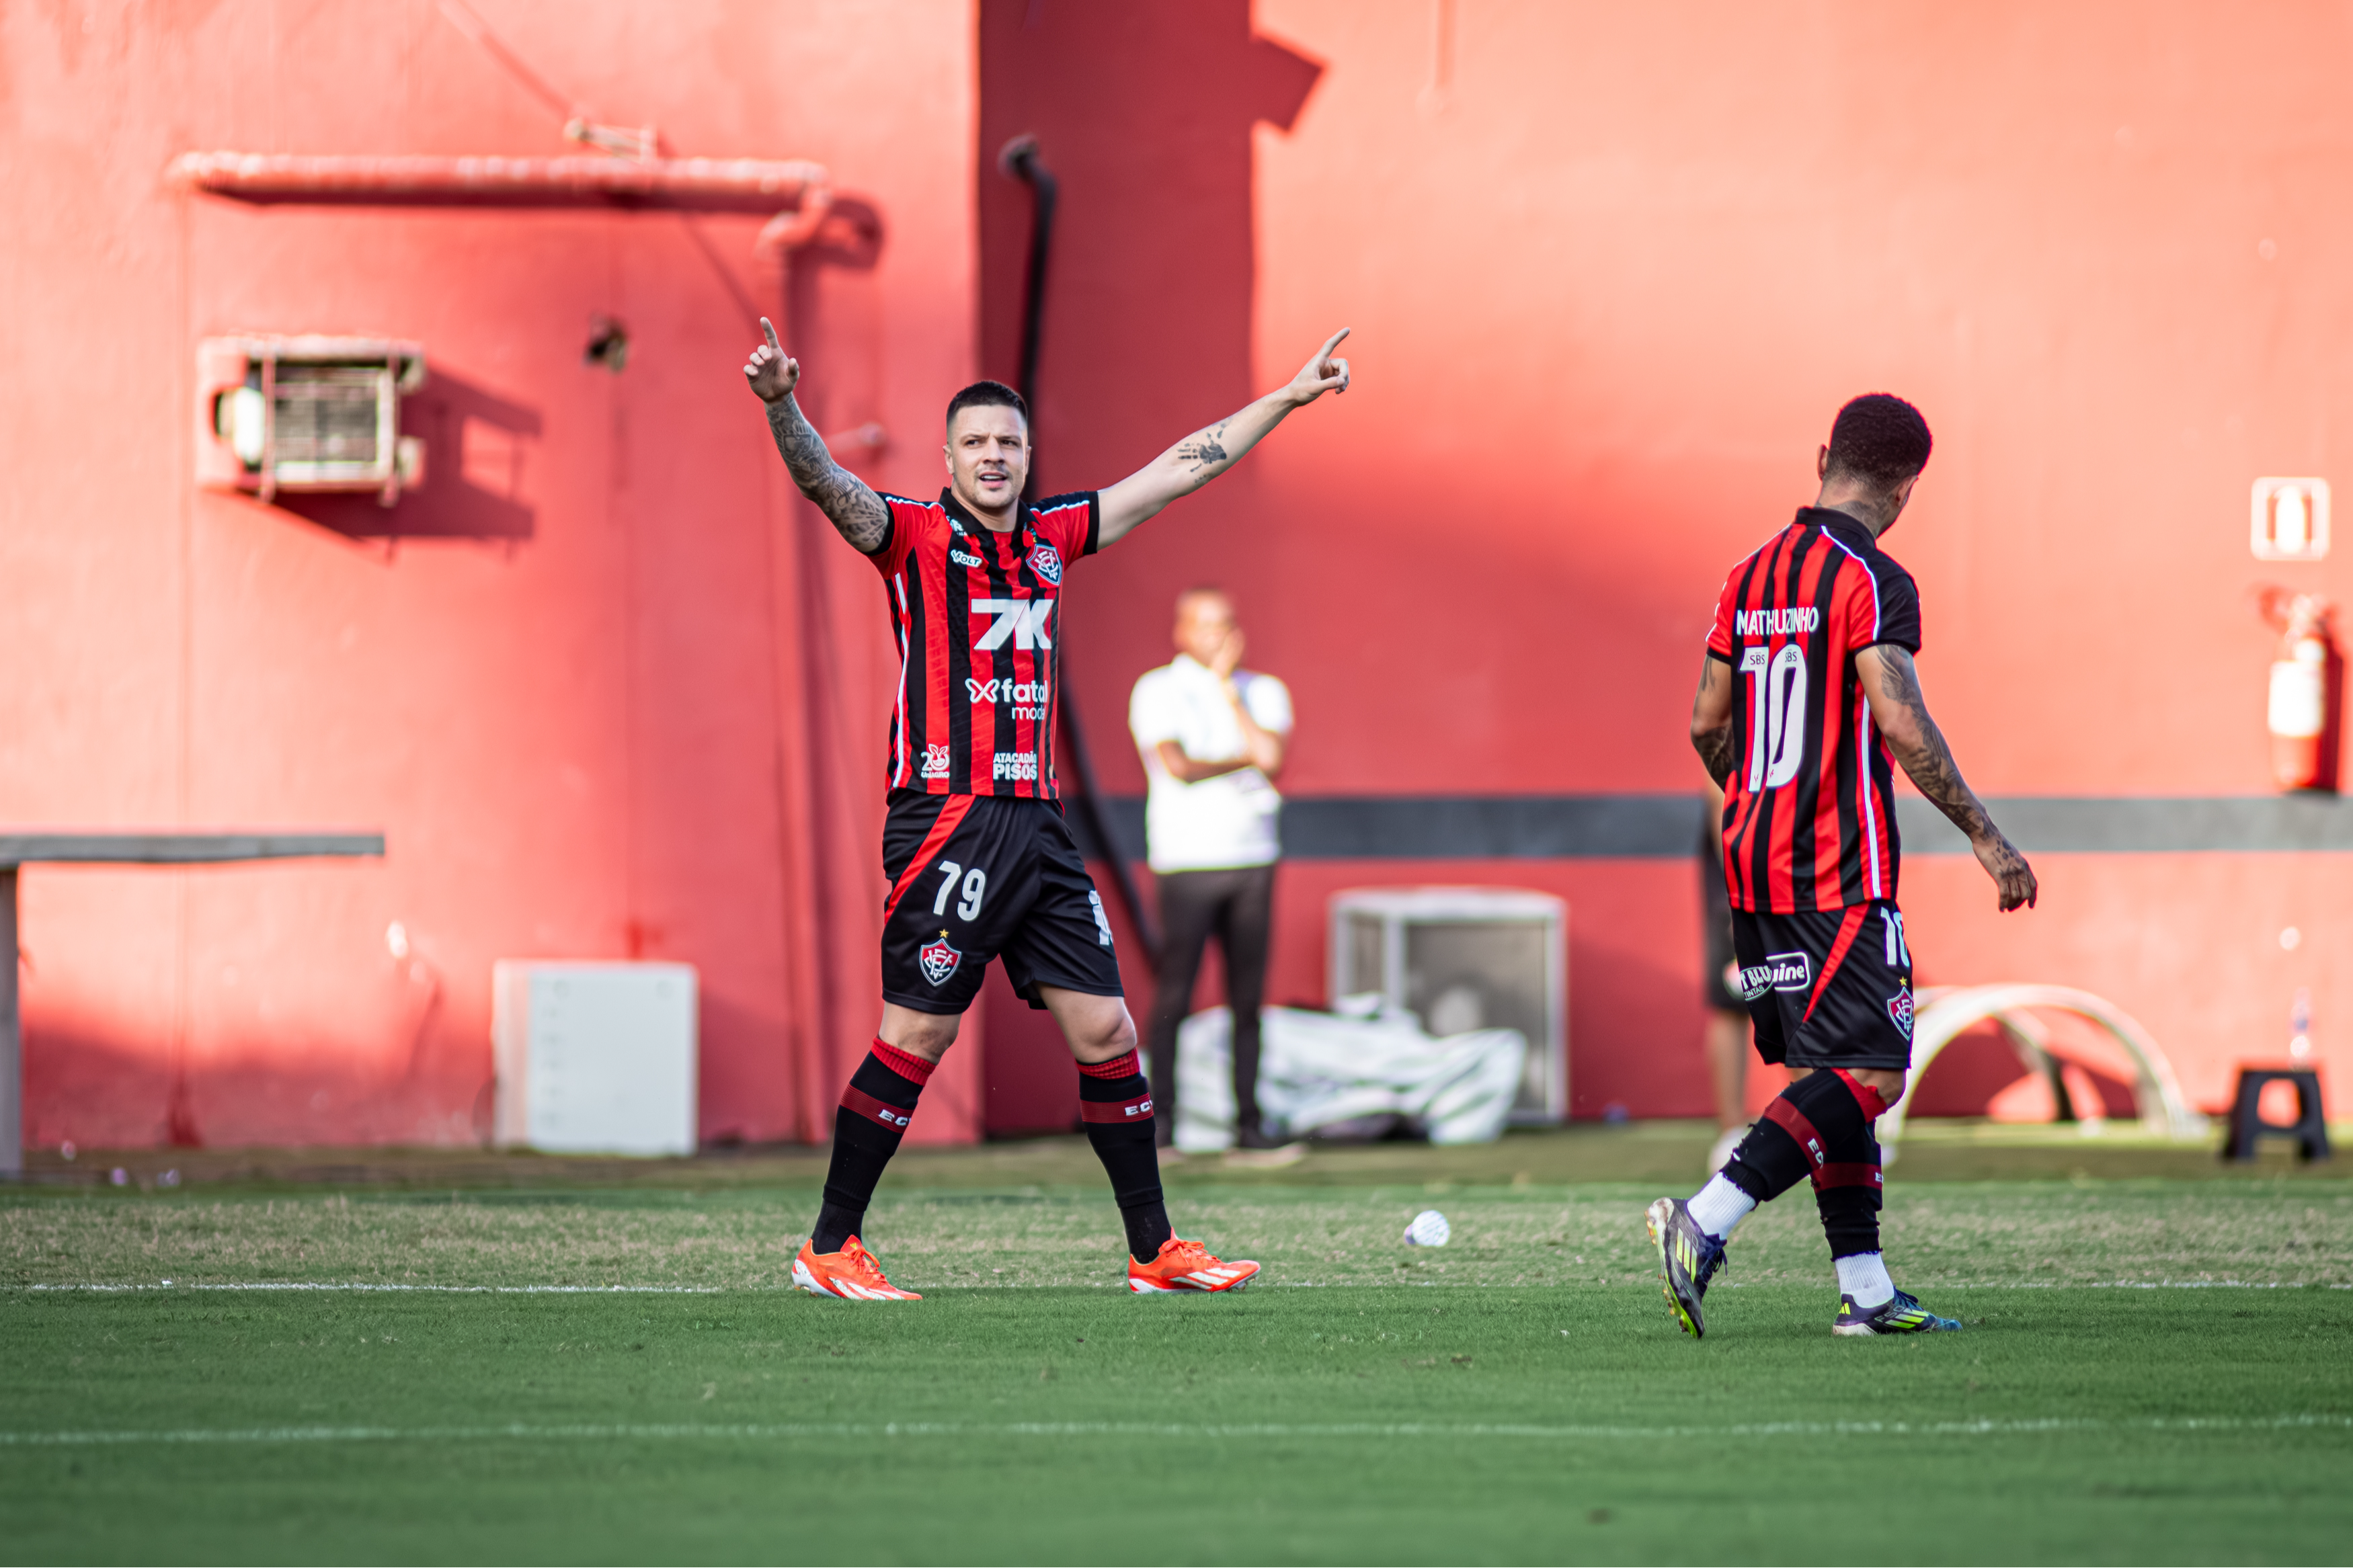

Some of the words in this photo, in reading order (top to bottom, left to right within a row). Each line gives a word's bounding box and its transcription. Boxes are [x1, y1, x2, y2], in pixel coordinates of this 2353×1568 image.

[951, 549, 982, 568] VOLT
[971, 598, 1053, 650] 7K
[1737, 607, 1819, 636] MATHUZINHO
[1749, 654, 1765, 665] SBS
[1001, 677, 1048, 703] fatal
[1739, 643, 1807, 792] 10
[993, 763, 1038, 780] PISOS
[933, 860, 986, 921] 79
[1744, 985, 1765, 999] TINTAS
[878, 1109, 911, 1126] EC
[1125, 1100, 1153, 1116] EC
[1807, 1138, 1824, 1169] EC
